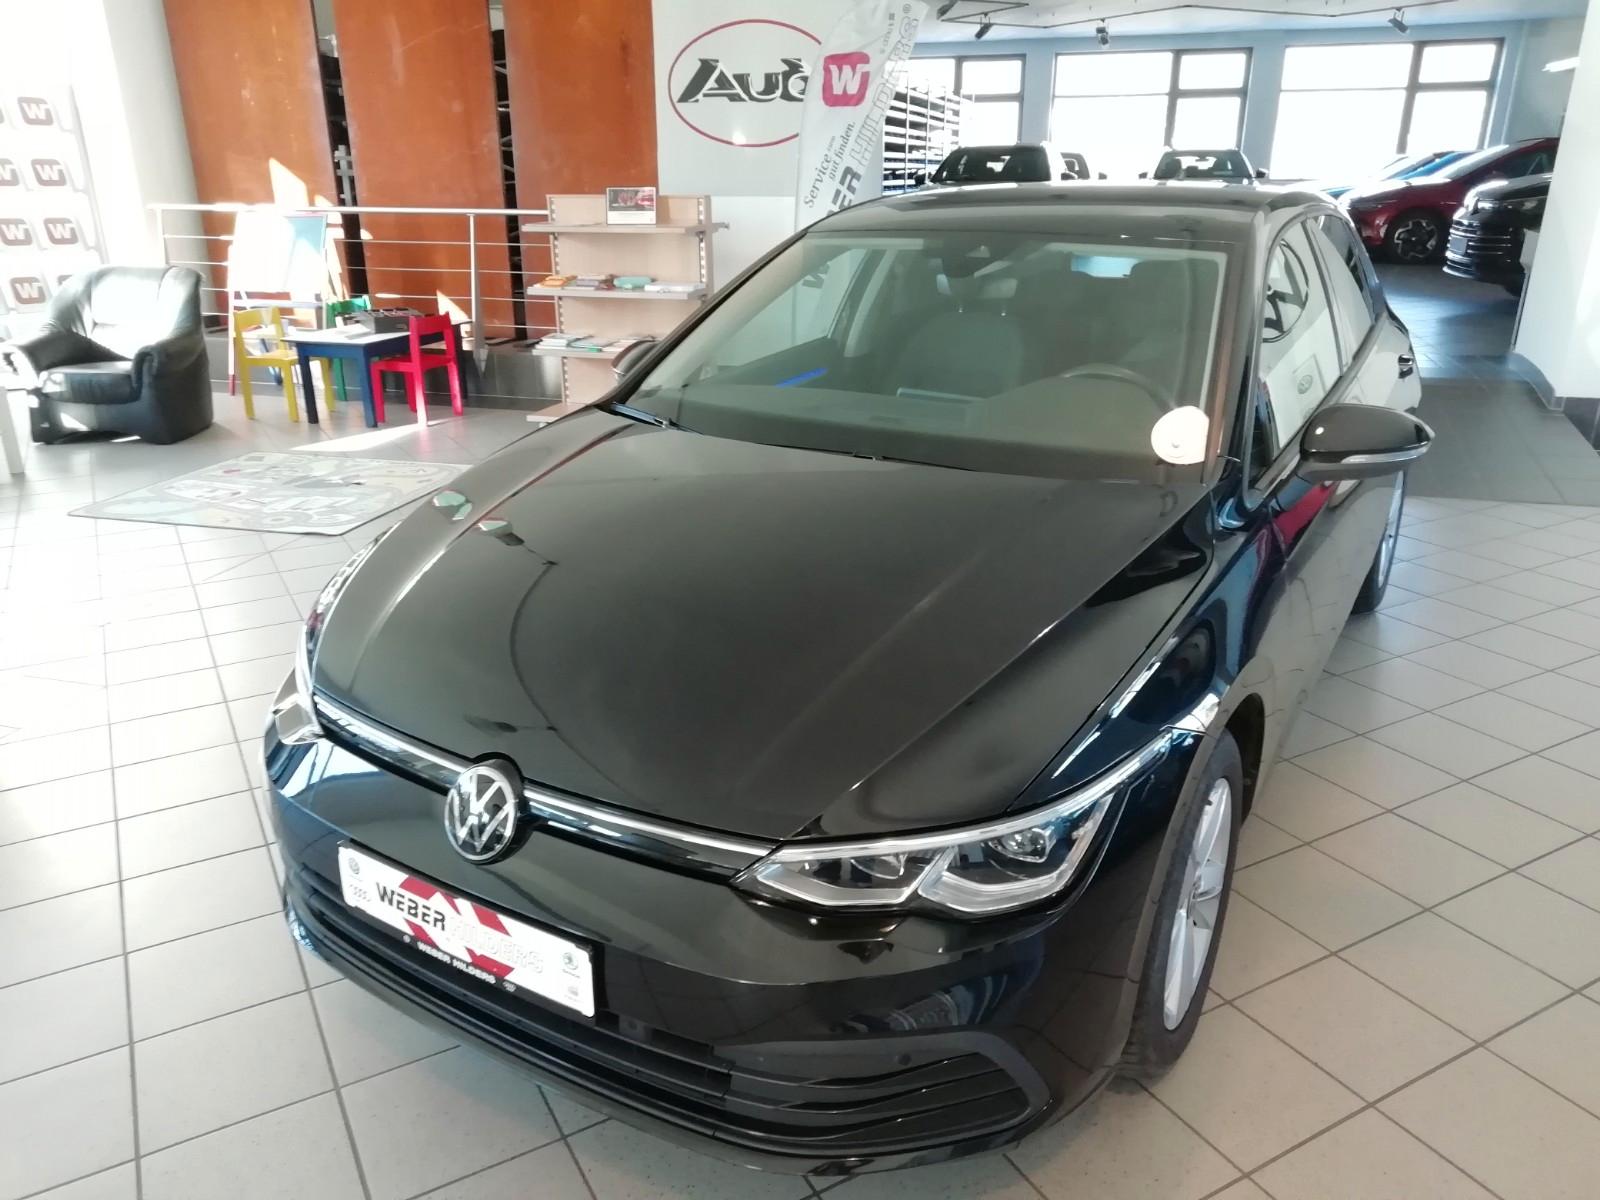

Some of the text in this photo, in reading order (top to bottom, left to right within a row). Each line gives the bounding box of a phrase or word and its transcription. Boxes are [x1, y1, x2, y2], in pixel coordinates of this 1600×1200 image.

[676, 58, 811, 103] Aud
[826, 60, 871, 99] W
[20, 100, 51, 122] W
[33, 162, 65, 184] W
[803, 153, 832, 208] Service
[1, 221, 76, 243] W W
[12, 280, 44, 301] W
[376, 882, 446, 932] WEBER
